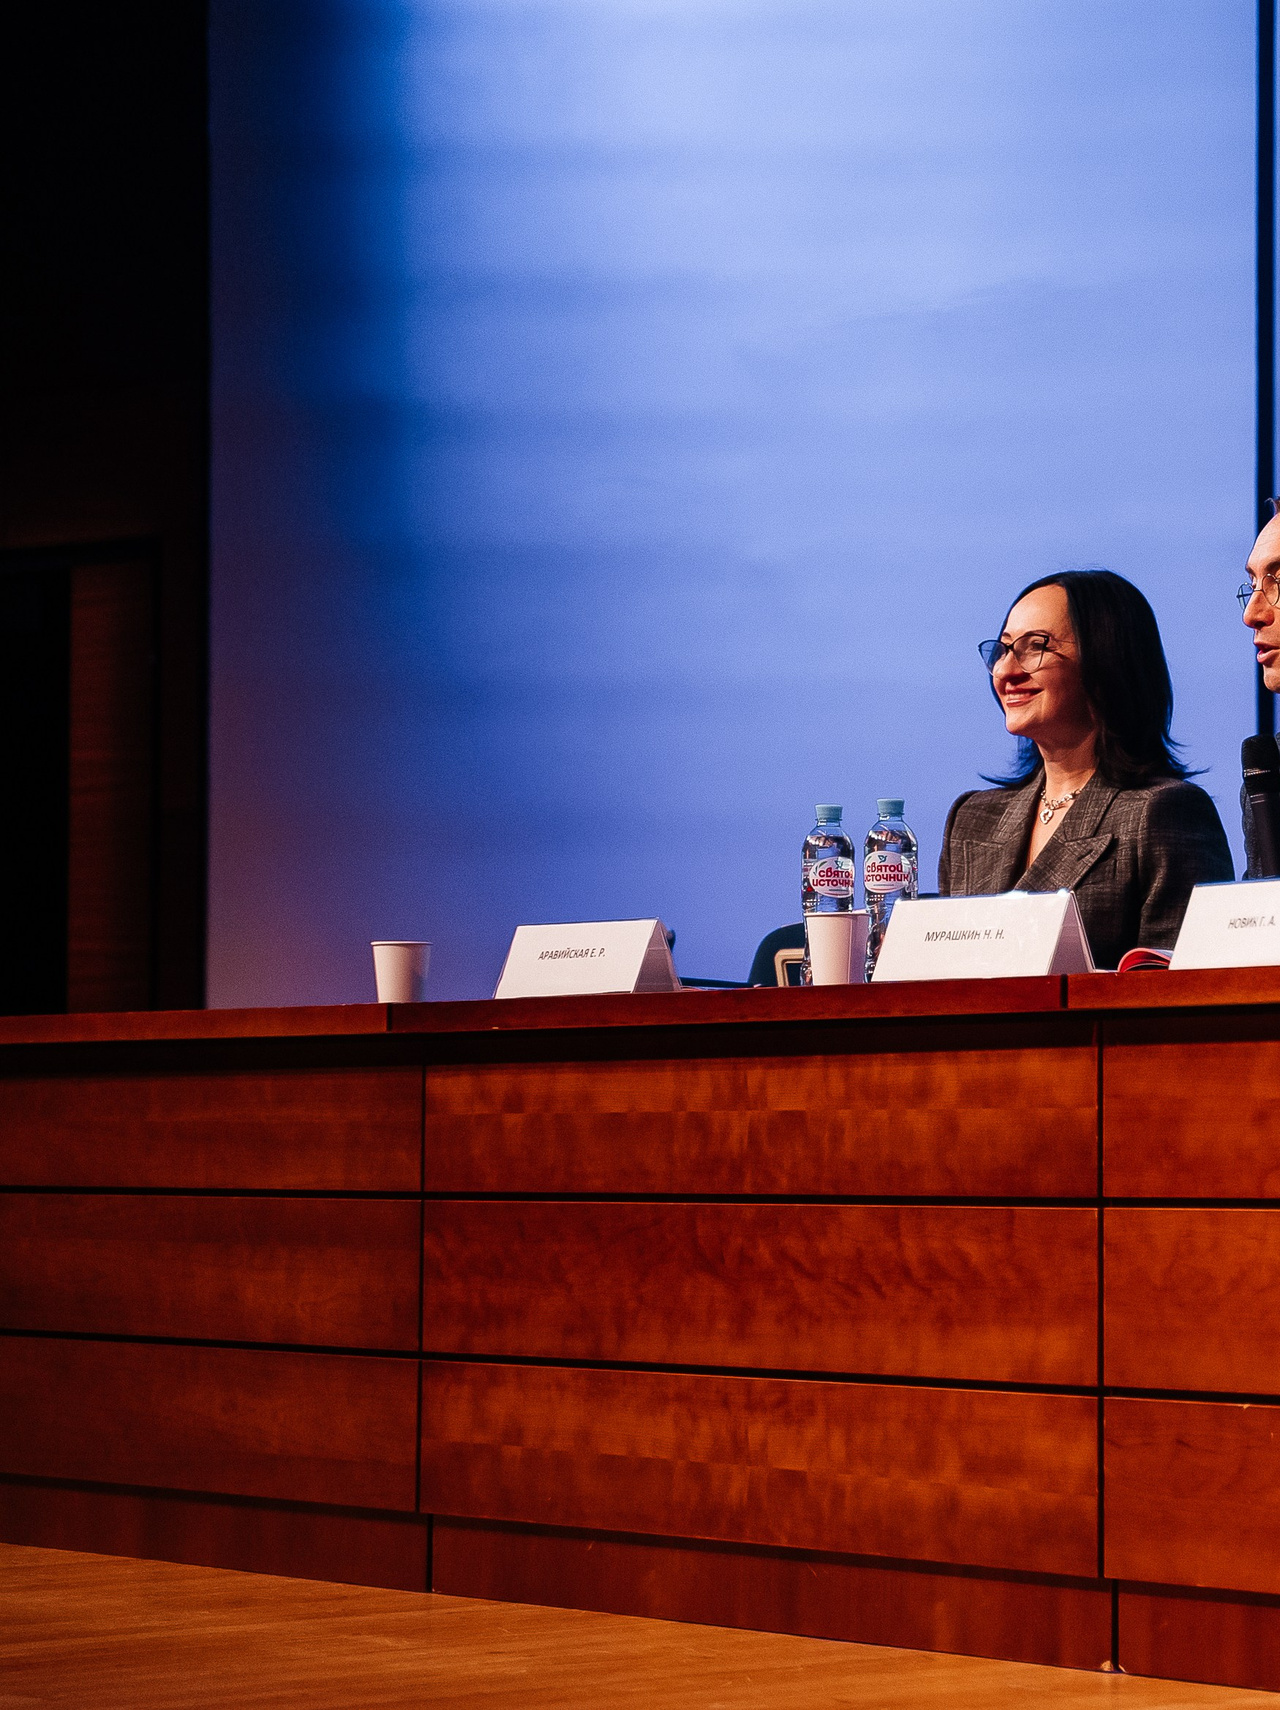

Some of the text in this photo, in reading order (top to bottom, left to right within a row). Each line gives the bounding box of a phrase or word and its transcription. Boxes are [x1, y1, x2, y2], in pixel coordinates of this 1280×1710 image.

[1228, 917, 1258, 928] НОВИК
[924, 930, 981, 941] МУРАШКИН
[995, 929, 1004, 939] Н.
[538, 947, 605, 960] АРАВИЙСКАЯ Е. Р.
